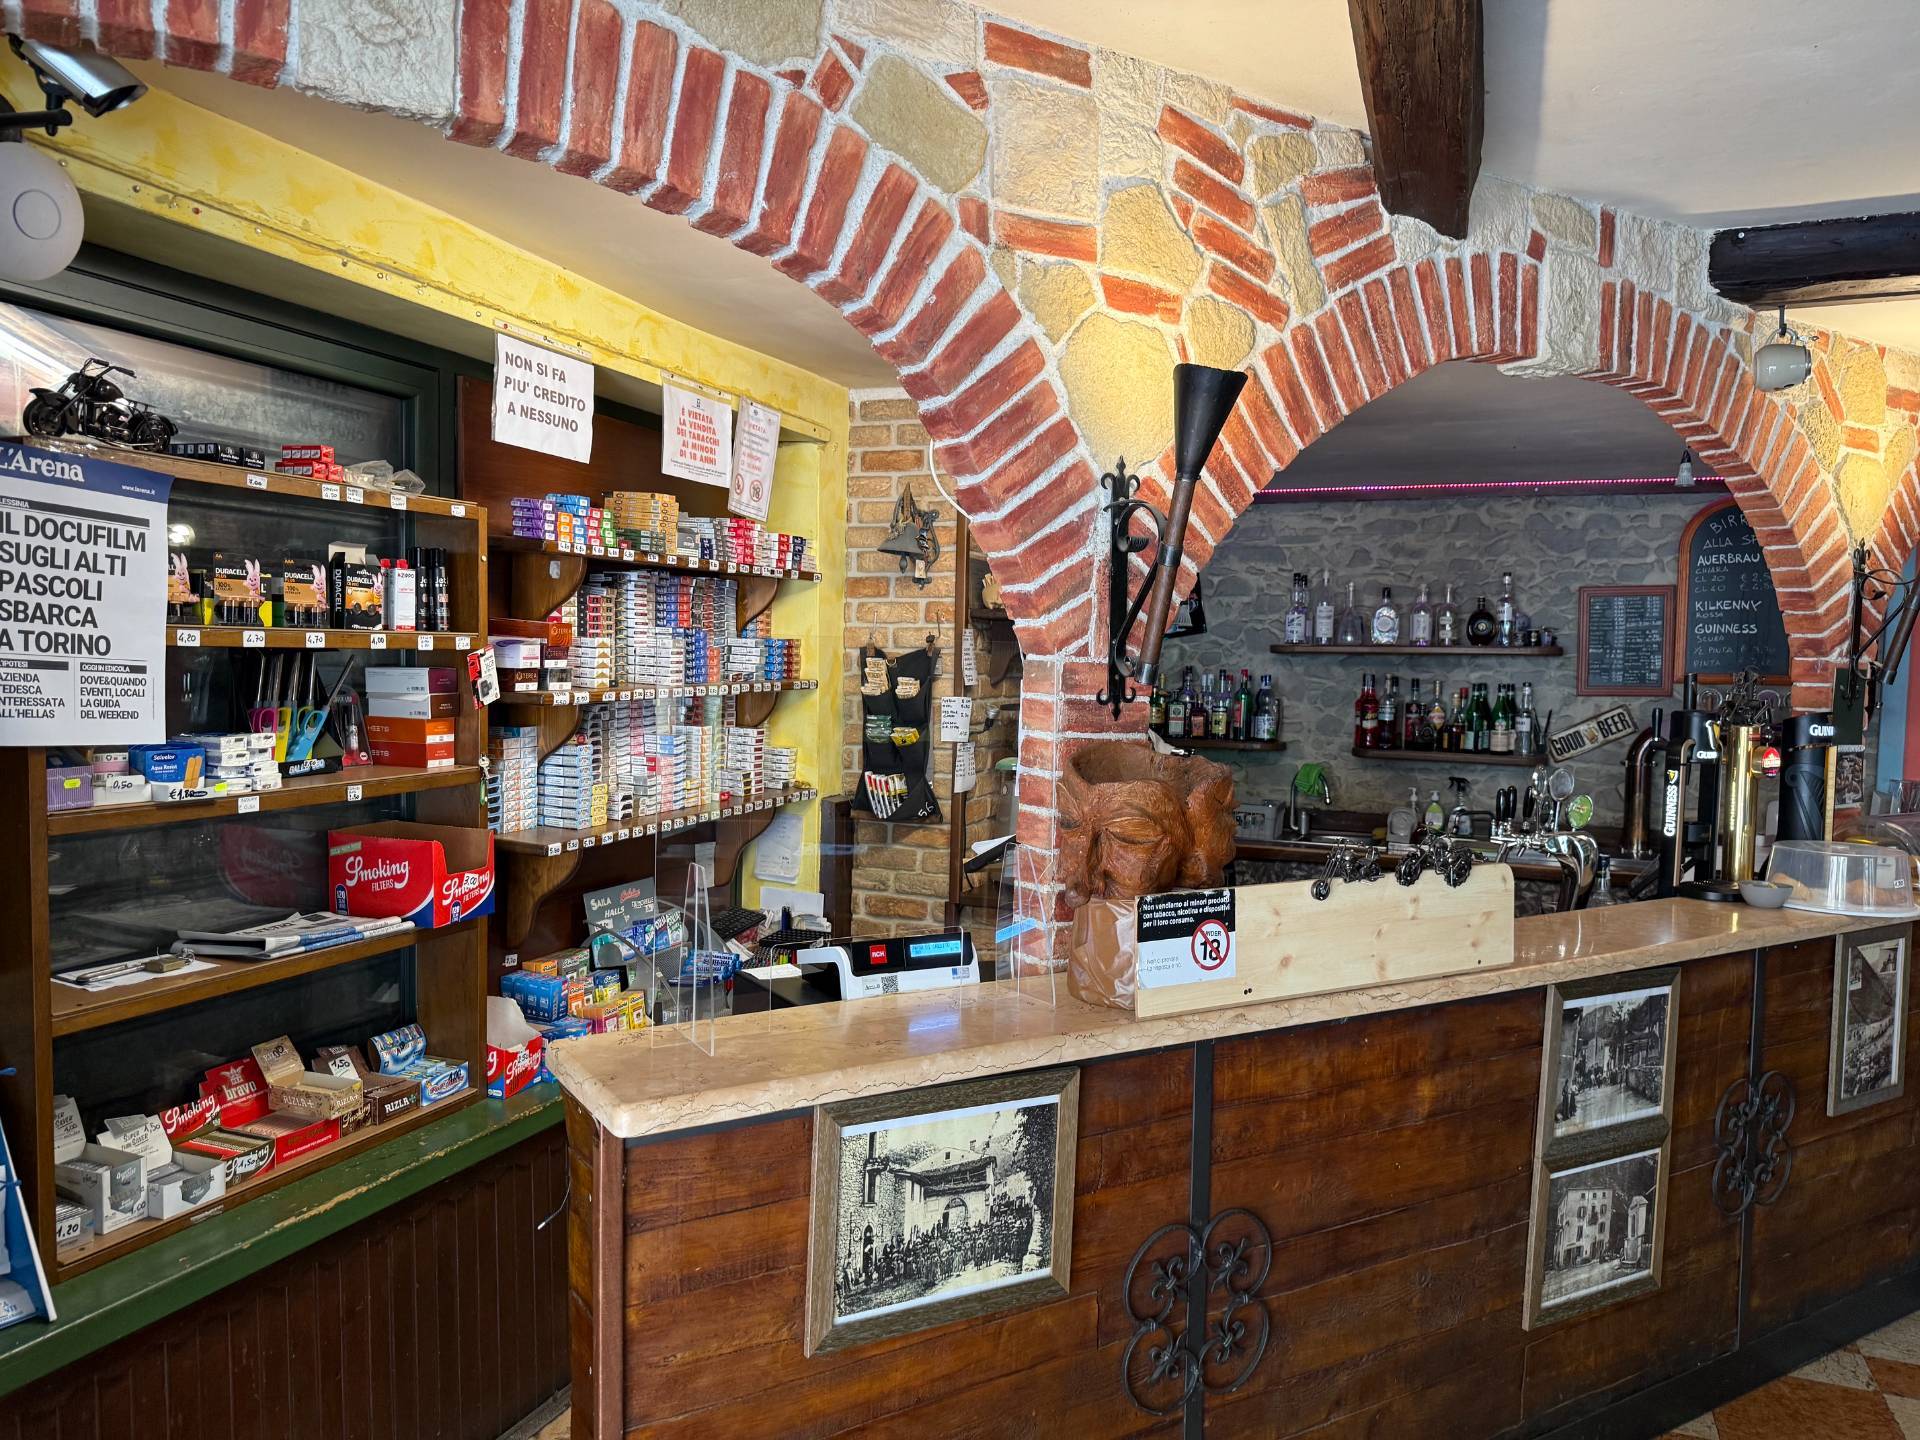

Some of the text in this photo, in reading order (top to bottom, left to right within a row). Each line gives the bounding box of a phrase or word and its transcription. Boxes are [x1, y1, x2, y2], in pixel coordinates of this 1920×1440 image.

[505, 351, 566, 383] NON SI FA
[504, 376, 586, 412] PIU' CREDITO
[508, 402, 578, 432] A NESSUNO
[688, 409, 714, 425] VIETATA
[678, 418, 716, 436] LA VENDITA
[677, 427, 720, 446] DEI TABACCHI
[682, 440, 716, 456] AI MINORI
[680, 450, 716, 466] DI 18 ANNI
[0, 510, 146, 552] IL DOCUFILM
[1710, 514, 1748, 534] BIRR
[1703, 537, 1733, 550] ALLA
[0, 540, 126, 576] SUGLI ALTI
[1697, 553, 1760, 566] AUERBRAU
[216, 567, 247, 576] DURACELL
[285, 572, 314, 580] DURACELL
[0, 570, 102, 601] PASCOLI
[347, 576, 373, 584] DURACELL
[0, 598, 98, 628] SBARCA
[1695, 600, 1762, 612] KILKENNY
[1695, 624, 1758, 634] GUINNESS
[0, 628, 112, 656] A TORINO
[0, 660, 28, 668] 'IPOTESI
[82, 664, 97, 672] OGGI
[80, 676, 147, 687] DOVE&QUANDO
[80, 687, 145, 698] EVENTI, LOCALI
[0, 696, 65, 707] NTERESSATA
[80, 699, 120, 708] LA GUIDA
[0, 708, 55, 718] LL'HELLAS
[80, 710, 139, 720] DEL WEEKEND
[1551, 712, 1631, 756] GOOD BEER
[1664, 785, 1678, 836] GUINNESS
[346, 856, 409, 888] Smoking
[371, 879, 394, 892] FILTERS
[463, 888, 480, 902] FILTERS
[590, 897, 612, 910] SAILA
[1156, 902, 1182, 910] vendiamo
[1190, 898, 1206, 906] minori
[1208, 896, 1230, 905] prodotti
[604, 906, 625, 918] HALLS
[1154, 909, 1176, 918] tabacco,
[1177, 907, 1198, 916] nicotina
[1204, 904, 1230, 914] dispositivi
[1200, 939, 1220, 961] 18
[224, 1080, 257, 1101] bravo
[165, 1094, 215, 1134] Smoking
[342, 1103, 371, 1128] Smoking
